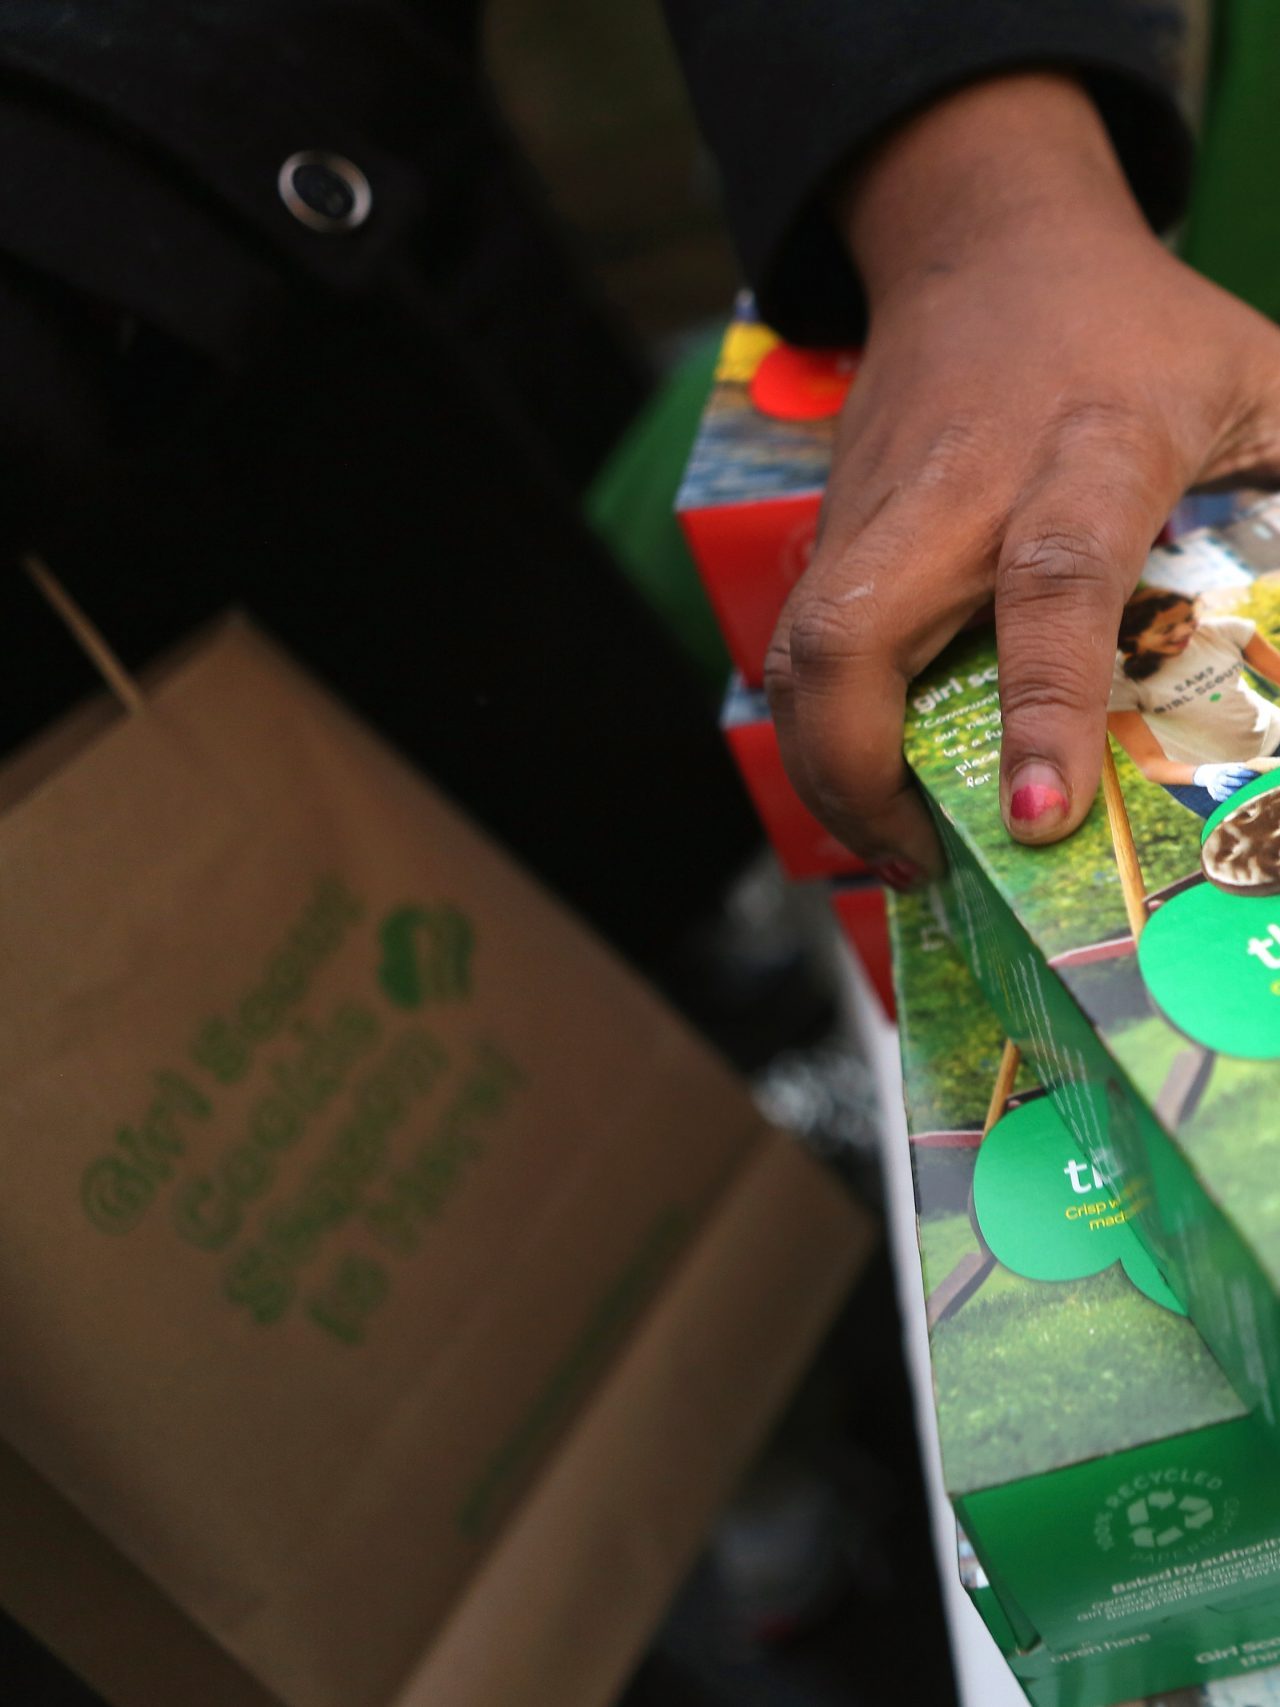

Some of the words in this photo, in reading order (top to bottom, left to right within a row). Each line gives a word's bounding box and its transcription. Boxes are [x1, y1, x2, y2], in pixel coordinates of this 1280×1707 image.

[914, 677, 964, 714] girl
[934, 727, 959, 743] our
[943, 744, 967, 758] be
[1065, 1201, 1107, 1221] Crisp
[1089, 1210, 1126, 1231] mad
[1105, 1466, 1223, 1509] RECYCLED
[1110, 1567, 1172, 1594] Baked
[1173, 1560, 1198, 1577] by
[1050, 1641, 1102, 1664] open
[1103, 1632, 1151, 1651] here
[1195, 1645, 1238, 1664] Girl
